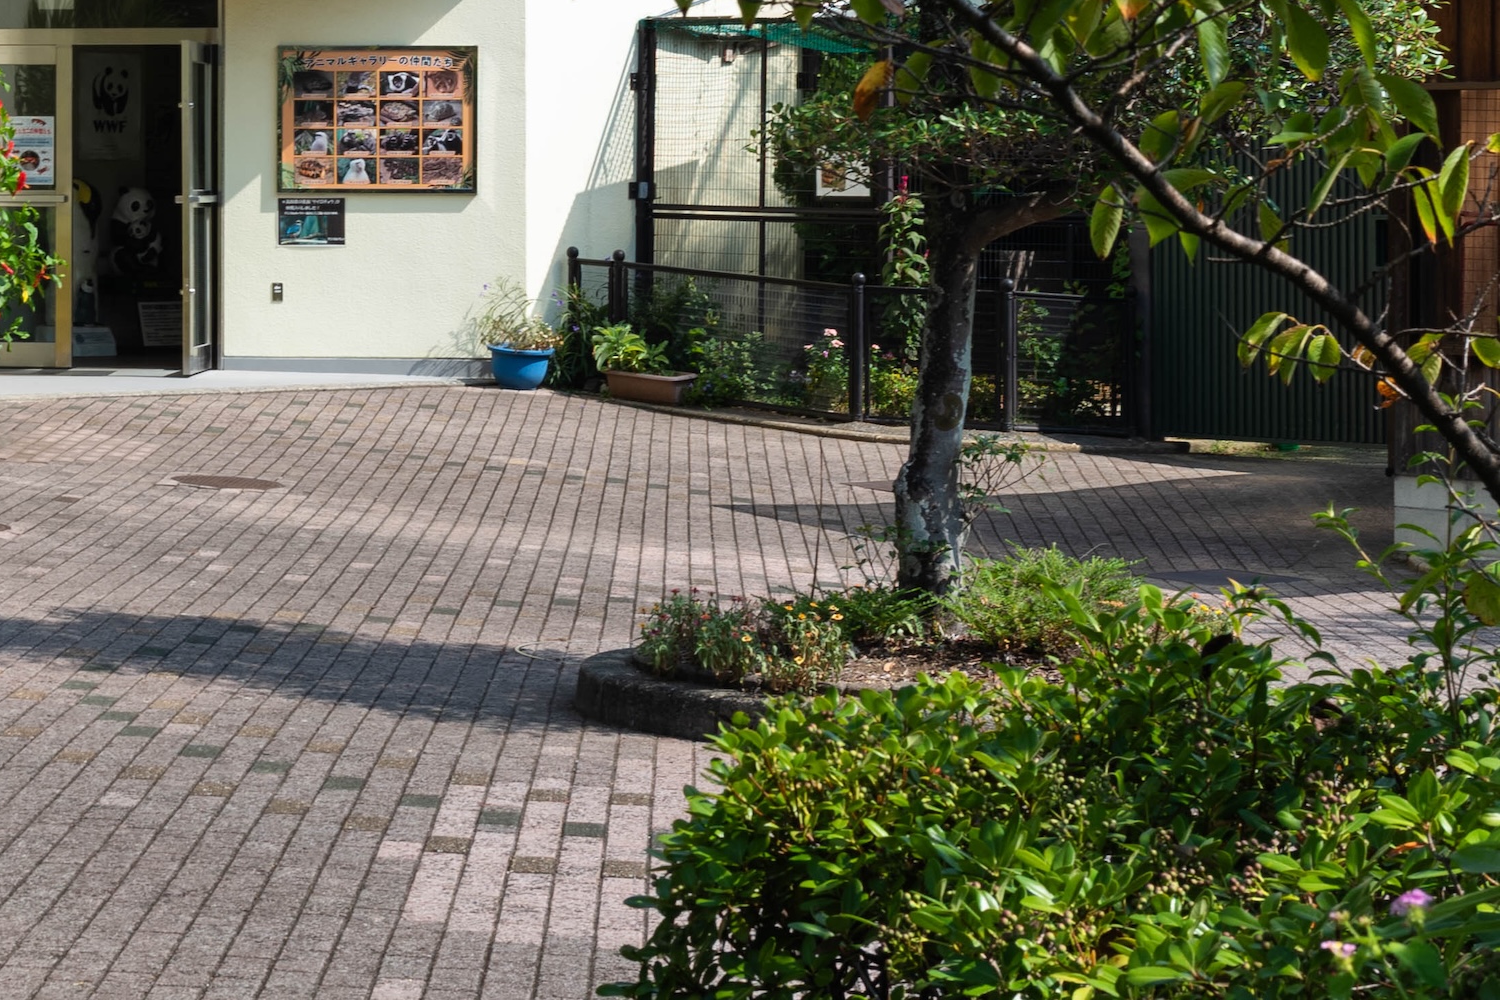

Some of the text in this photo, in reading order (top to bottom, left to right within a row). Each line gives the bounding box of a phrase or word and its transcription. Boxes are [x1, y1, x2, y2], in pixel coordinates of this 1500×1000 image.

[305, 55, 454, 68] アニマルギャラリーの仲間たち
[92, 119, 128, 134] WWF
